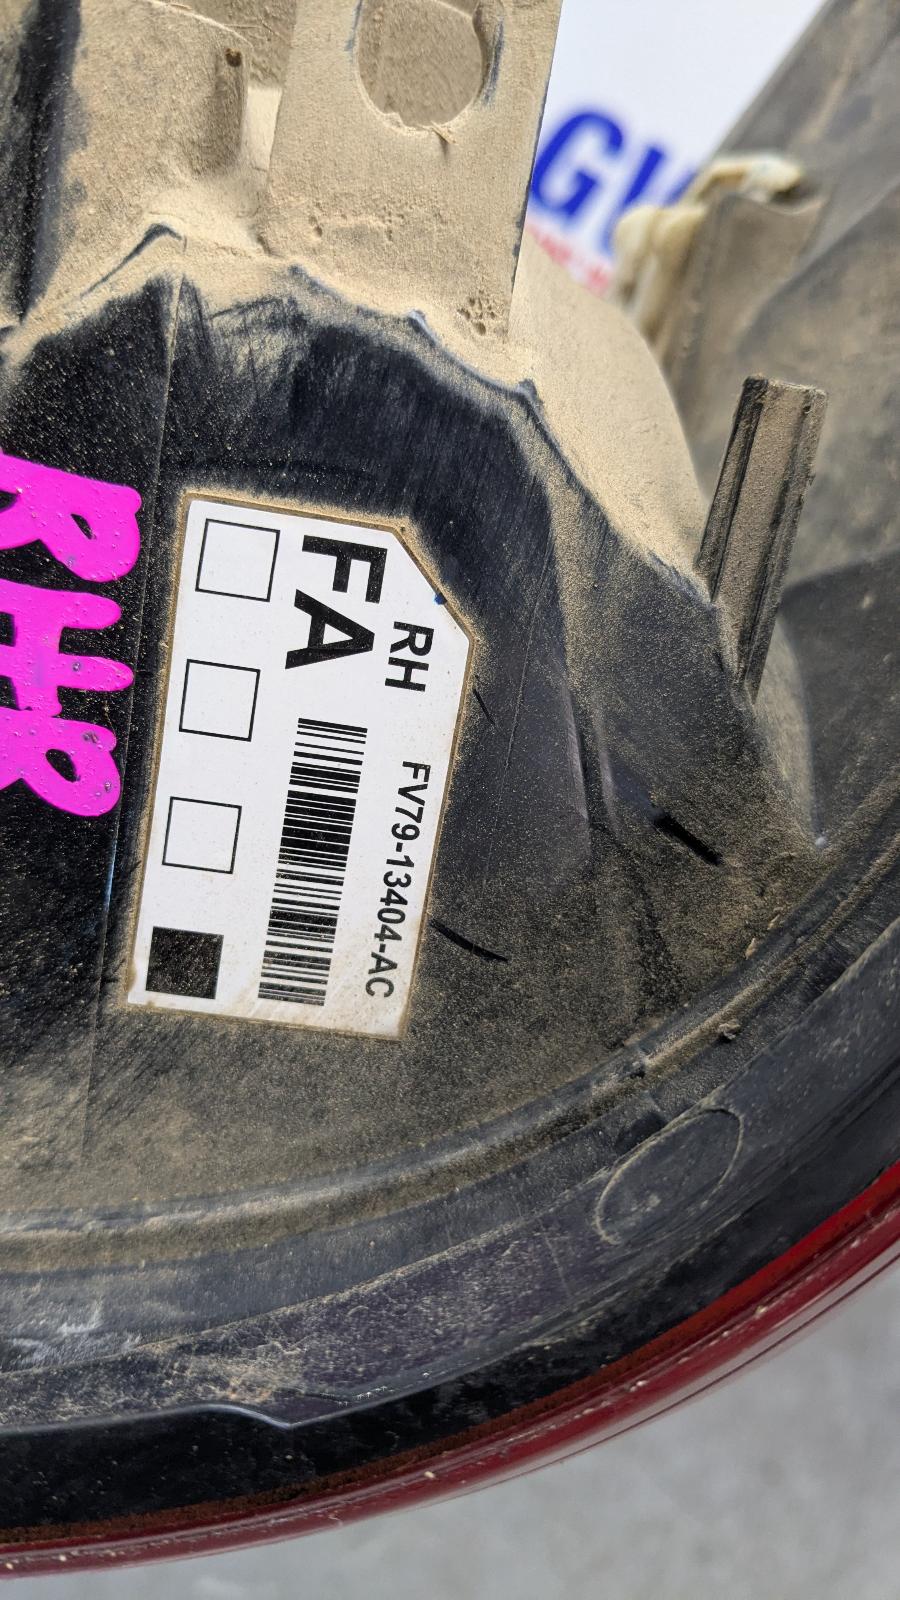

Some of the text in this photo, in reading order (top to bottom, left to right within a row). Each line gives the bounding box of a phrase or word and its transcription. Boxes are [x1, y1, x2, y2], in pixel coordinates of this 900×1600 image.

[285, 535, 388, 669] FA
[385, 621, 434, 692] RH
[365, 761, 431, 999] FV79-13404-AC
